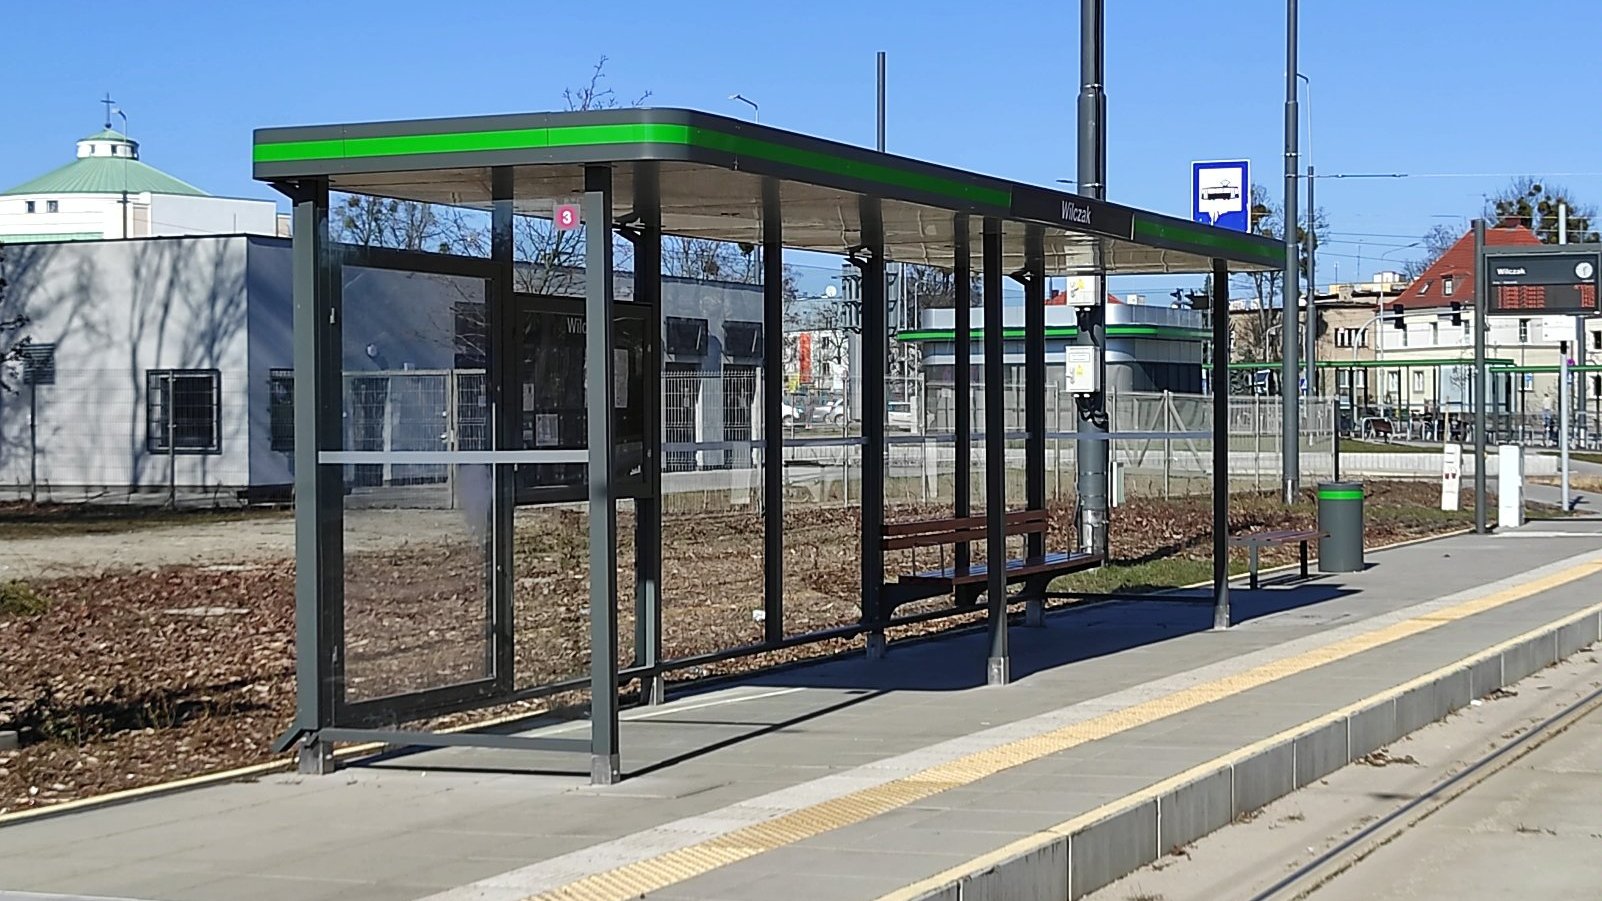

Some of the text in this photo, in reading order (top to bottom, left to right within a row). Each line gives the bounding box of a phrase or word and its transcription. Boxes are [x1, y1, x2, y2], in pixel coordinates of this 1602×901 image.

[562, 210, 572, 224] 3
[1062, 200, 1091, 224] Wilczak
[567, 317, 587, 334] Wilc
